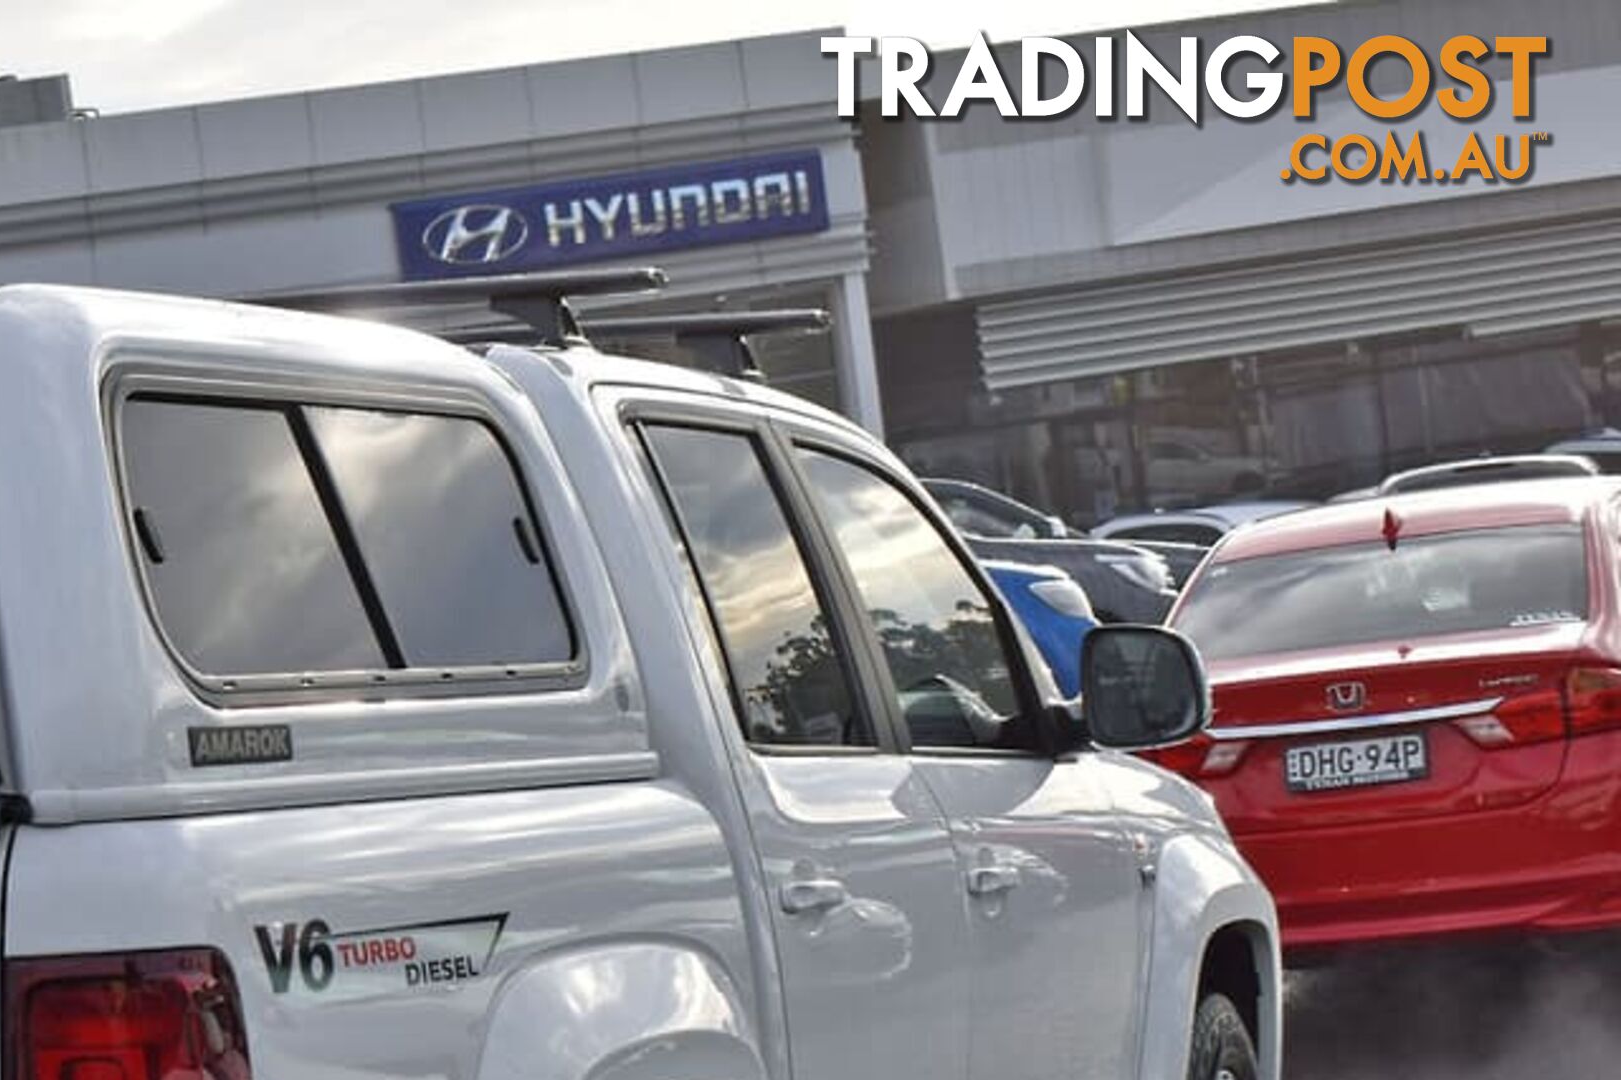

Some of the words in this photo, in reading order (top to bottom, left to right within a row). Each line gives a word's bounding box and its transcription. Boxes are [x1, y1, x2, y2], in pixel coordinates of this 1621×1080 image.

[545, 171, 809, 247] HYUNDAI
[195, 728, 288, 762] AMAROK
[255, 918, 334, 993] V6
[337, 937, 416, 968] TURBO
[405, 957, 479, 986] DIESEL
